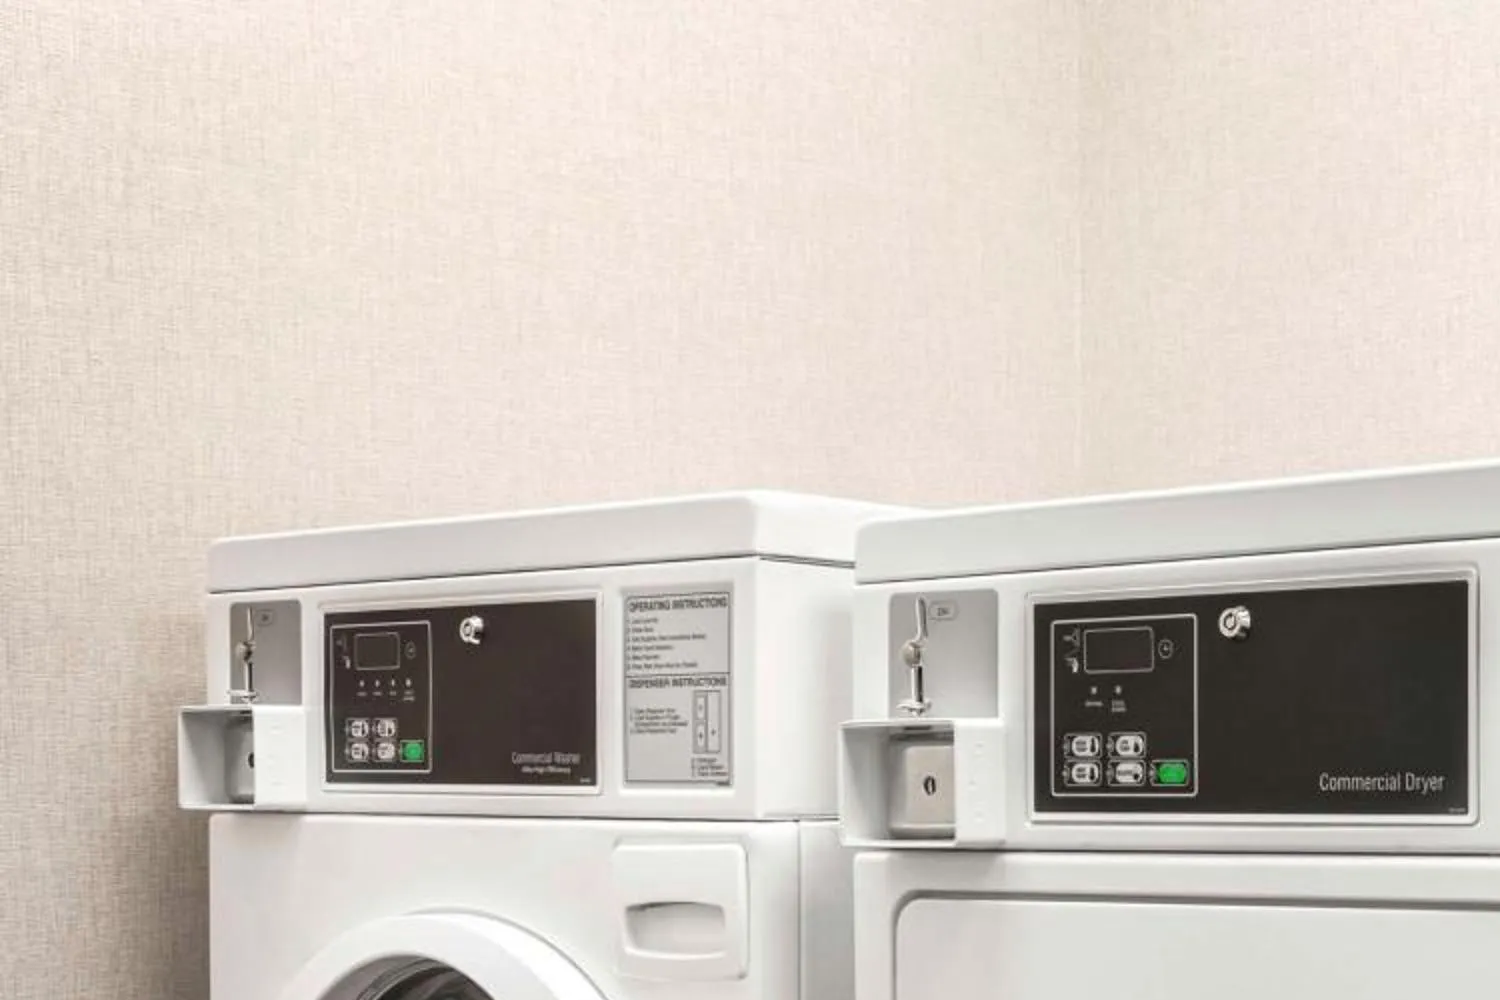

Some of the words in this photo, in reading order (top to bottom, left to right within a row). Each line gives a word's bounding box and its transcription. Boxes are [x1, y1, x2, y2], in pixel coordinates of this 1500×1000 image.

[628, 600, 670, 612] OPERATING
[672, 597, 727, 610] INSTRUCTIONS
[1319, 771, 1400, 791] Commercial
[1405, 771, 1445, 795] Dryer
